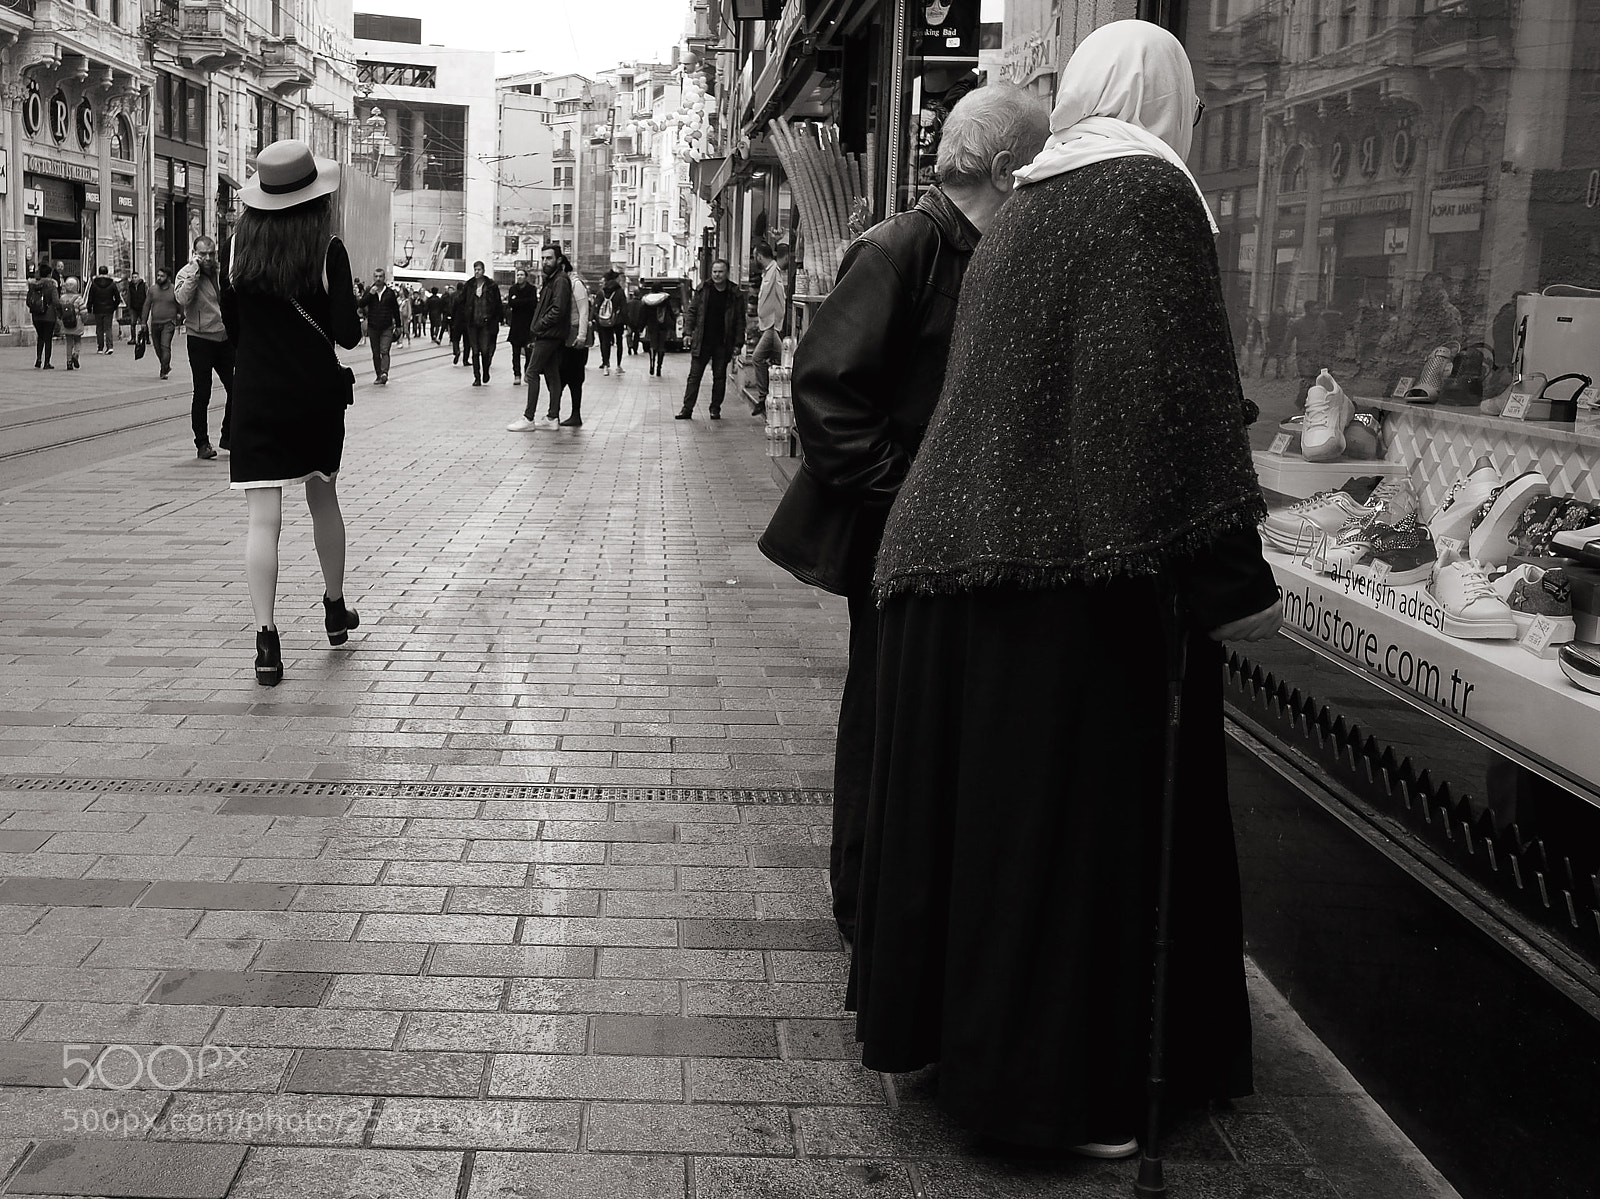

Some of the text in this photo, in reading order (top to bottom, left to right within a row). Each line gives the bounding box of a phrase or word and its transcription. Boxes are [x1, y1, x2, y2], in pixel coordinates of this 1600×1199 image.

[942, 27, 957, 36] Bad
[29, 81, 93, 146] ÖRS
[1399, 591, 1446, 632] adresi
